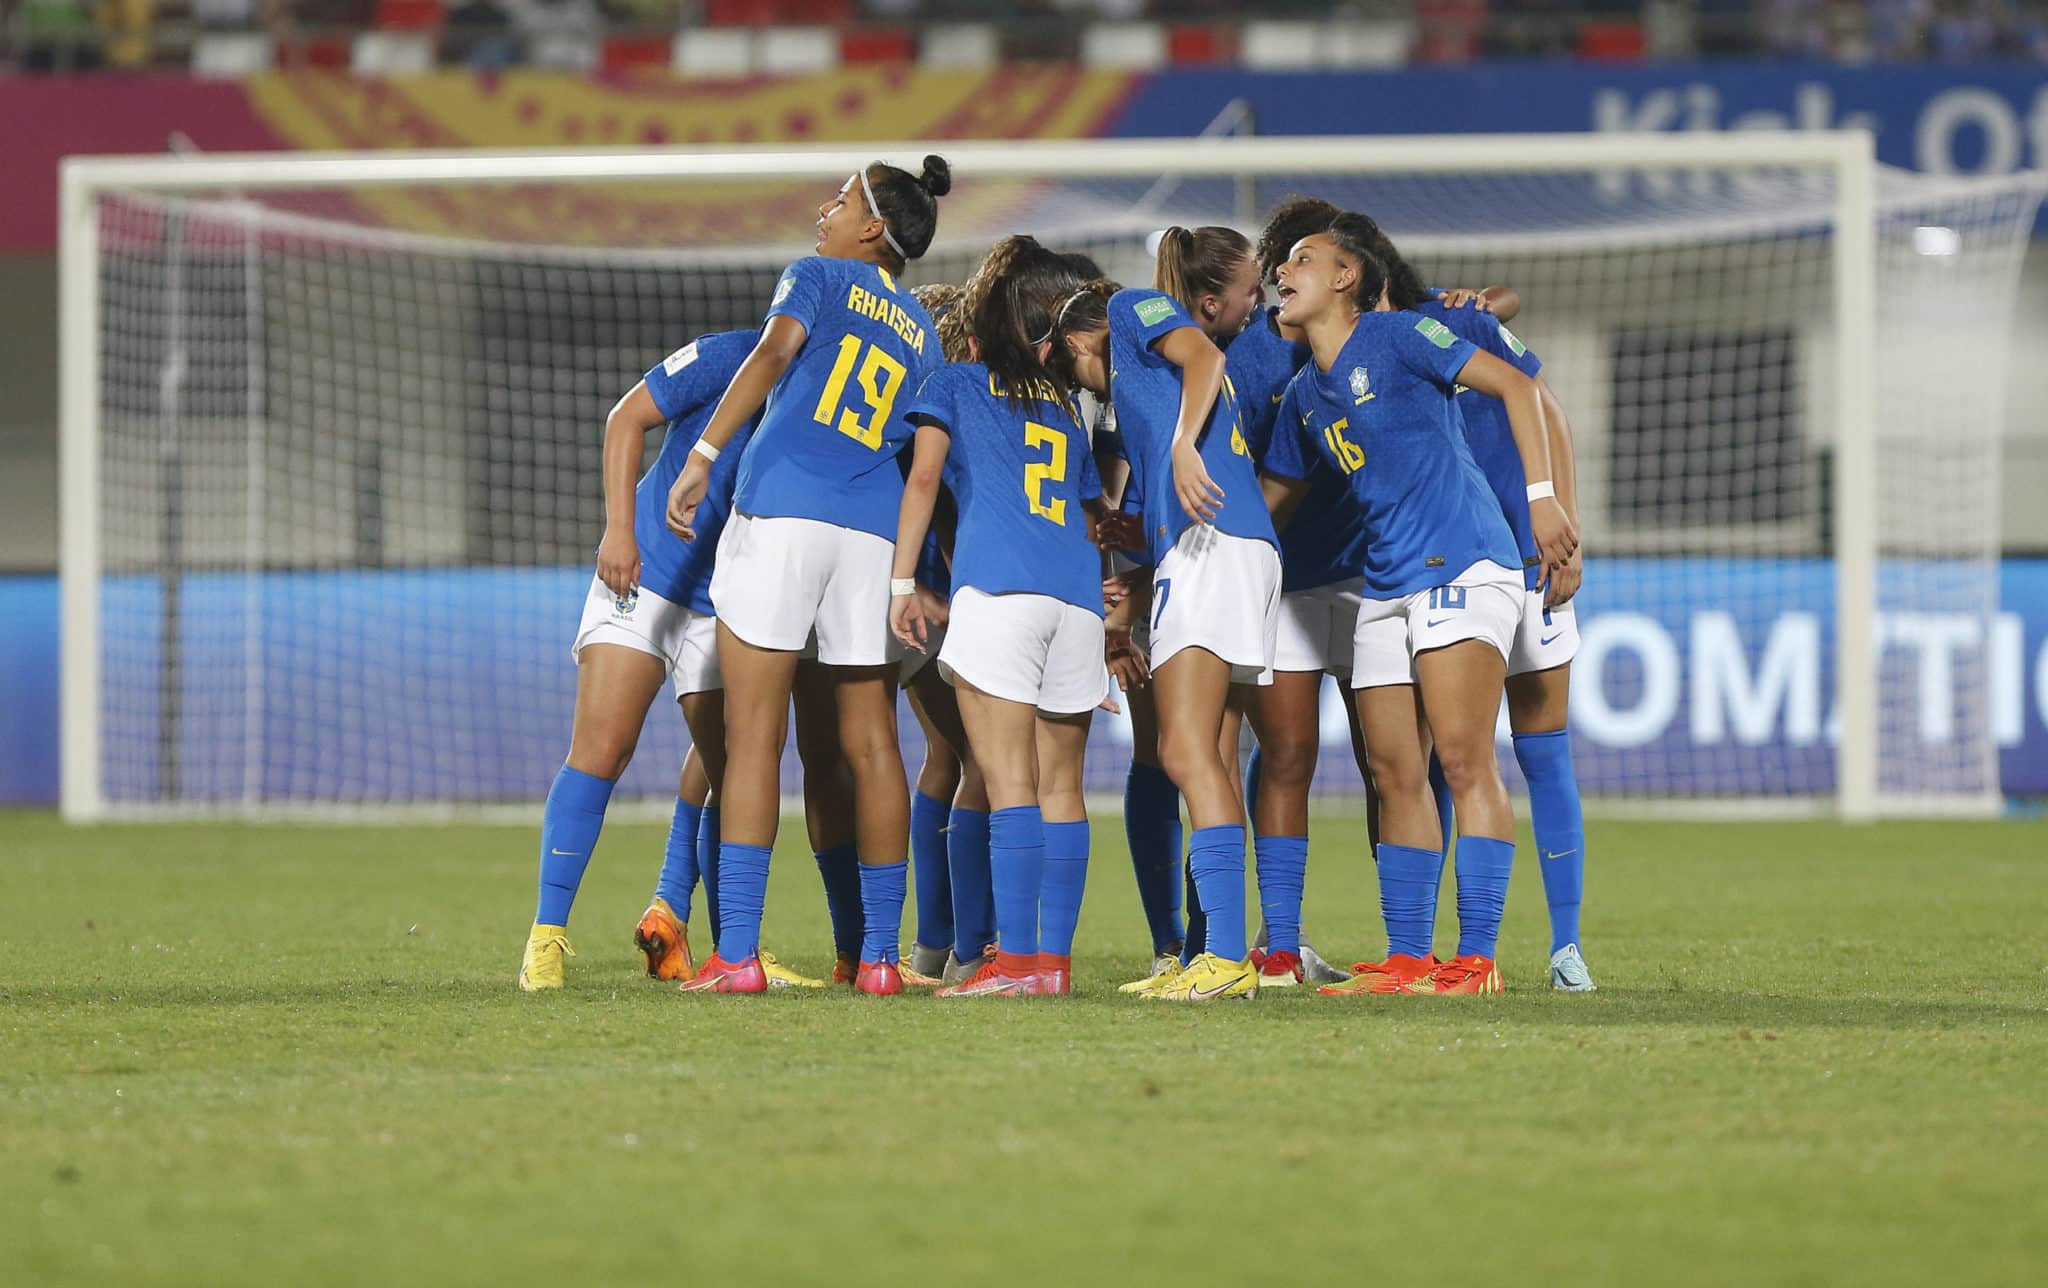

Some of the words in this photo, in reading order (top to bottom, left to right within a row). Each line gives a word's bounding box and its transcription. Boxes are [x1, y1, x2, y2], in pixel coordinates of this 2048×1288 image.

[847, 284, 925, 355] RHAISSA
[813, 333, 907, 452] 19
[1024, 421, 1067, 527] 2
[1324, 417, 1365, 474] 16
